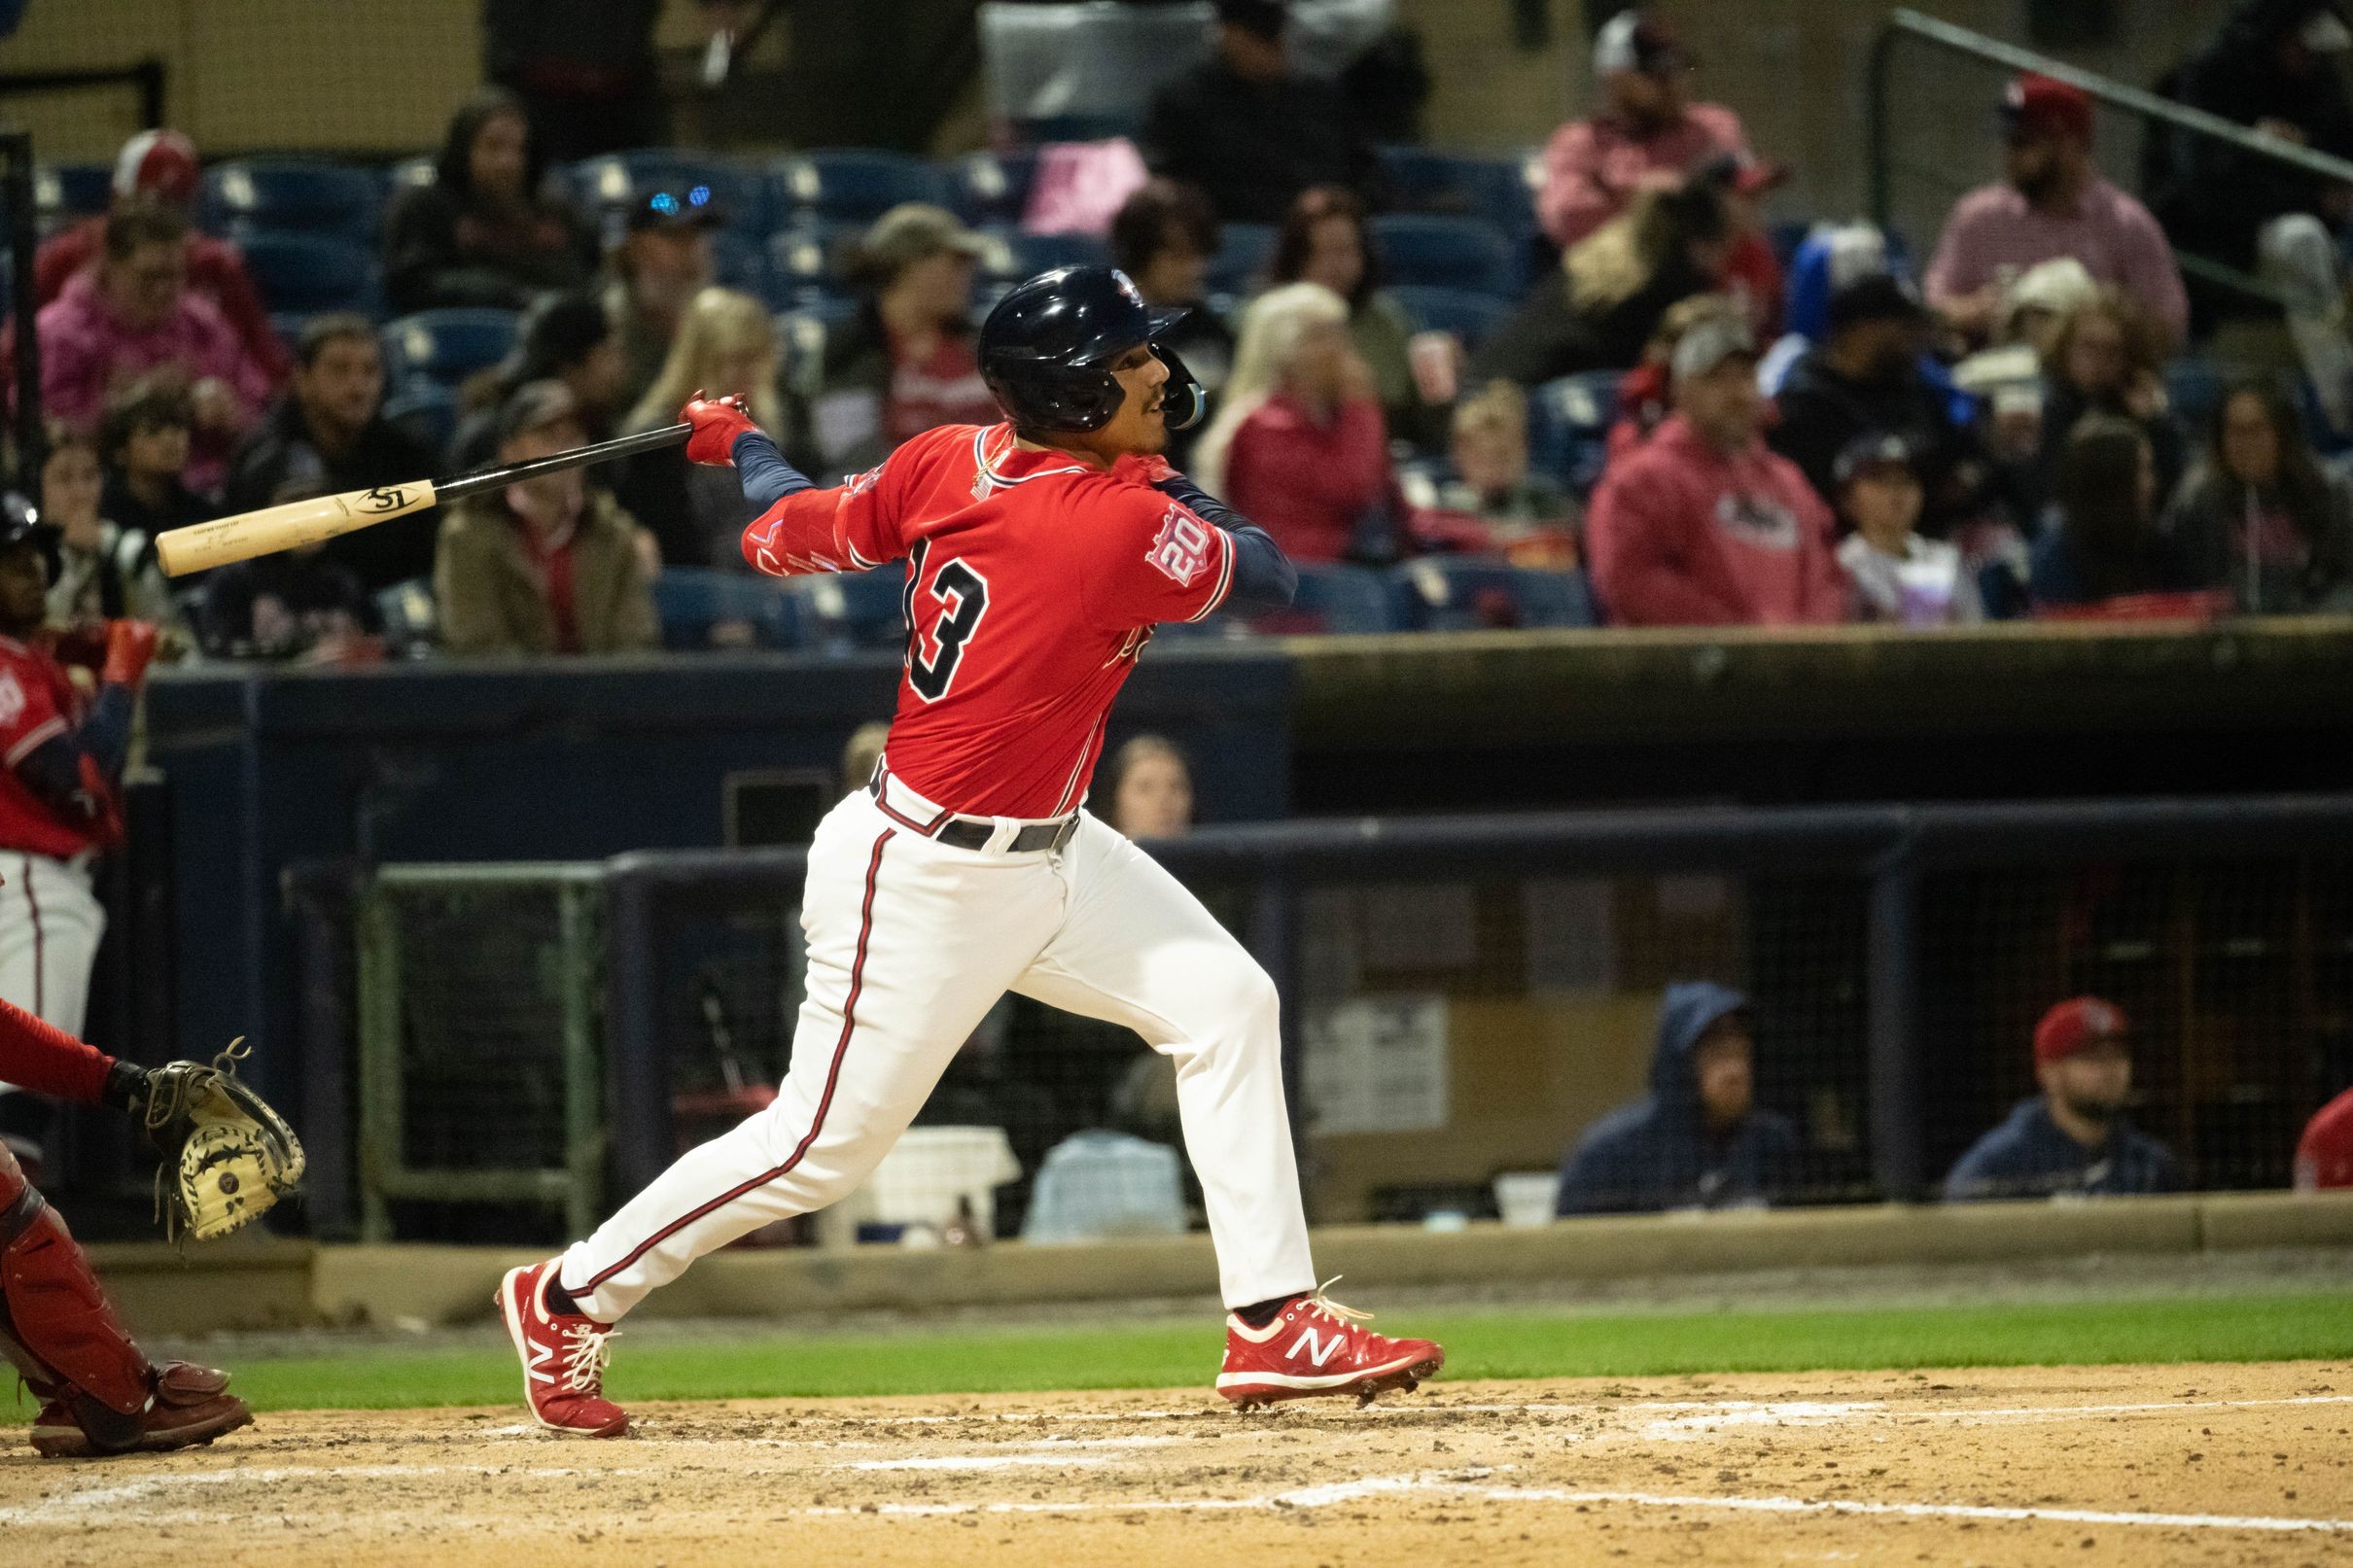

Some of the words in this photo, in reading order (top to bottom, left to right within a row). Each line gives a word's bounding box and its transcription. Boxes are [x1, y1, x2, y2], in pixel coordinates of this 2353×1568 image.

[1160, 517, 1207, 581] 20
[527, 1336, 555, 1384] N
[1284, 1326, 1345, 1368] N
